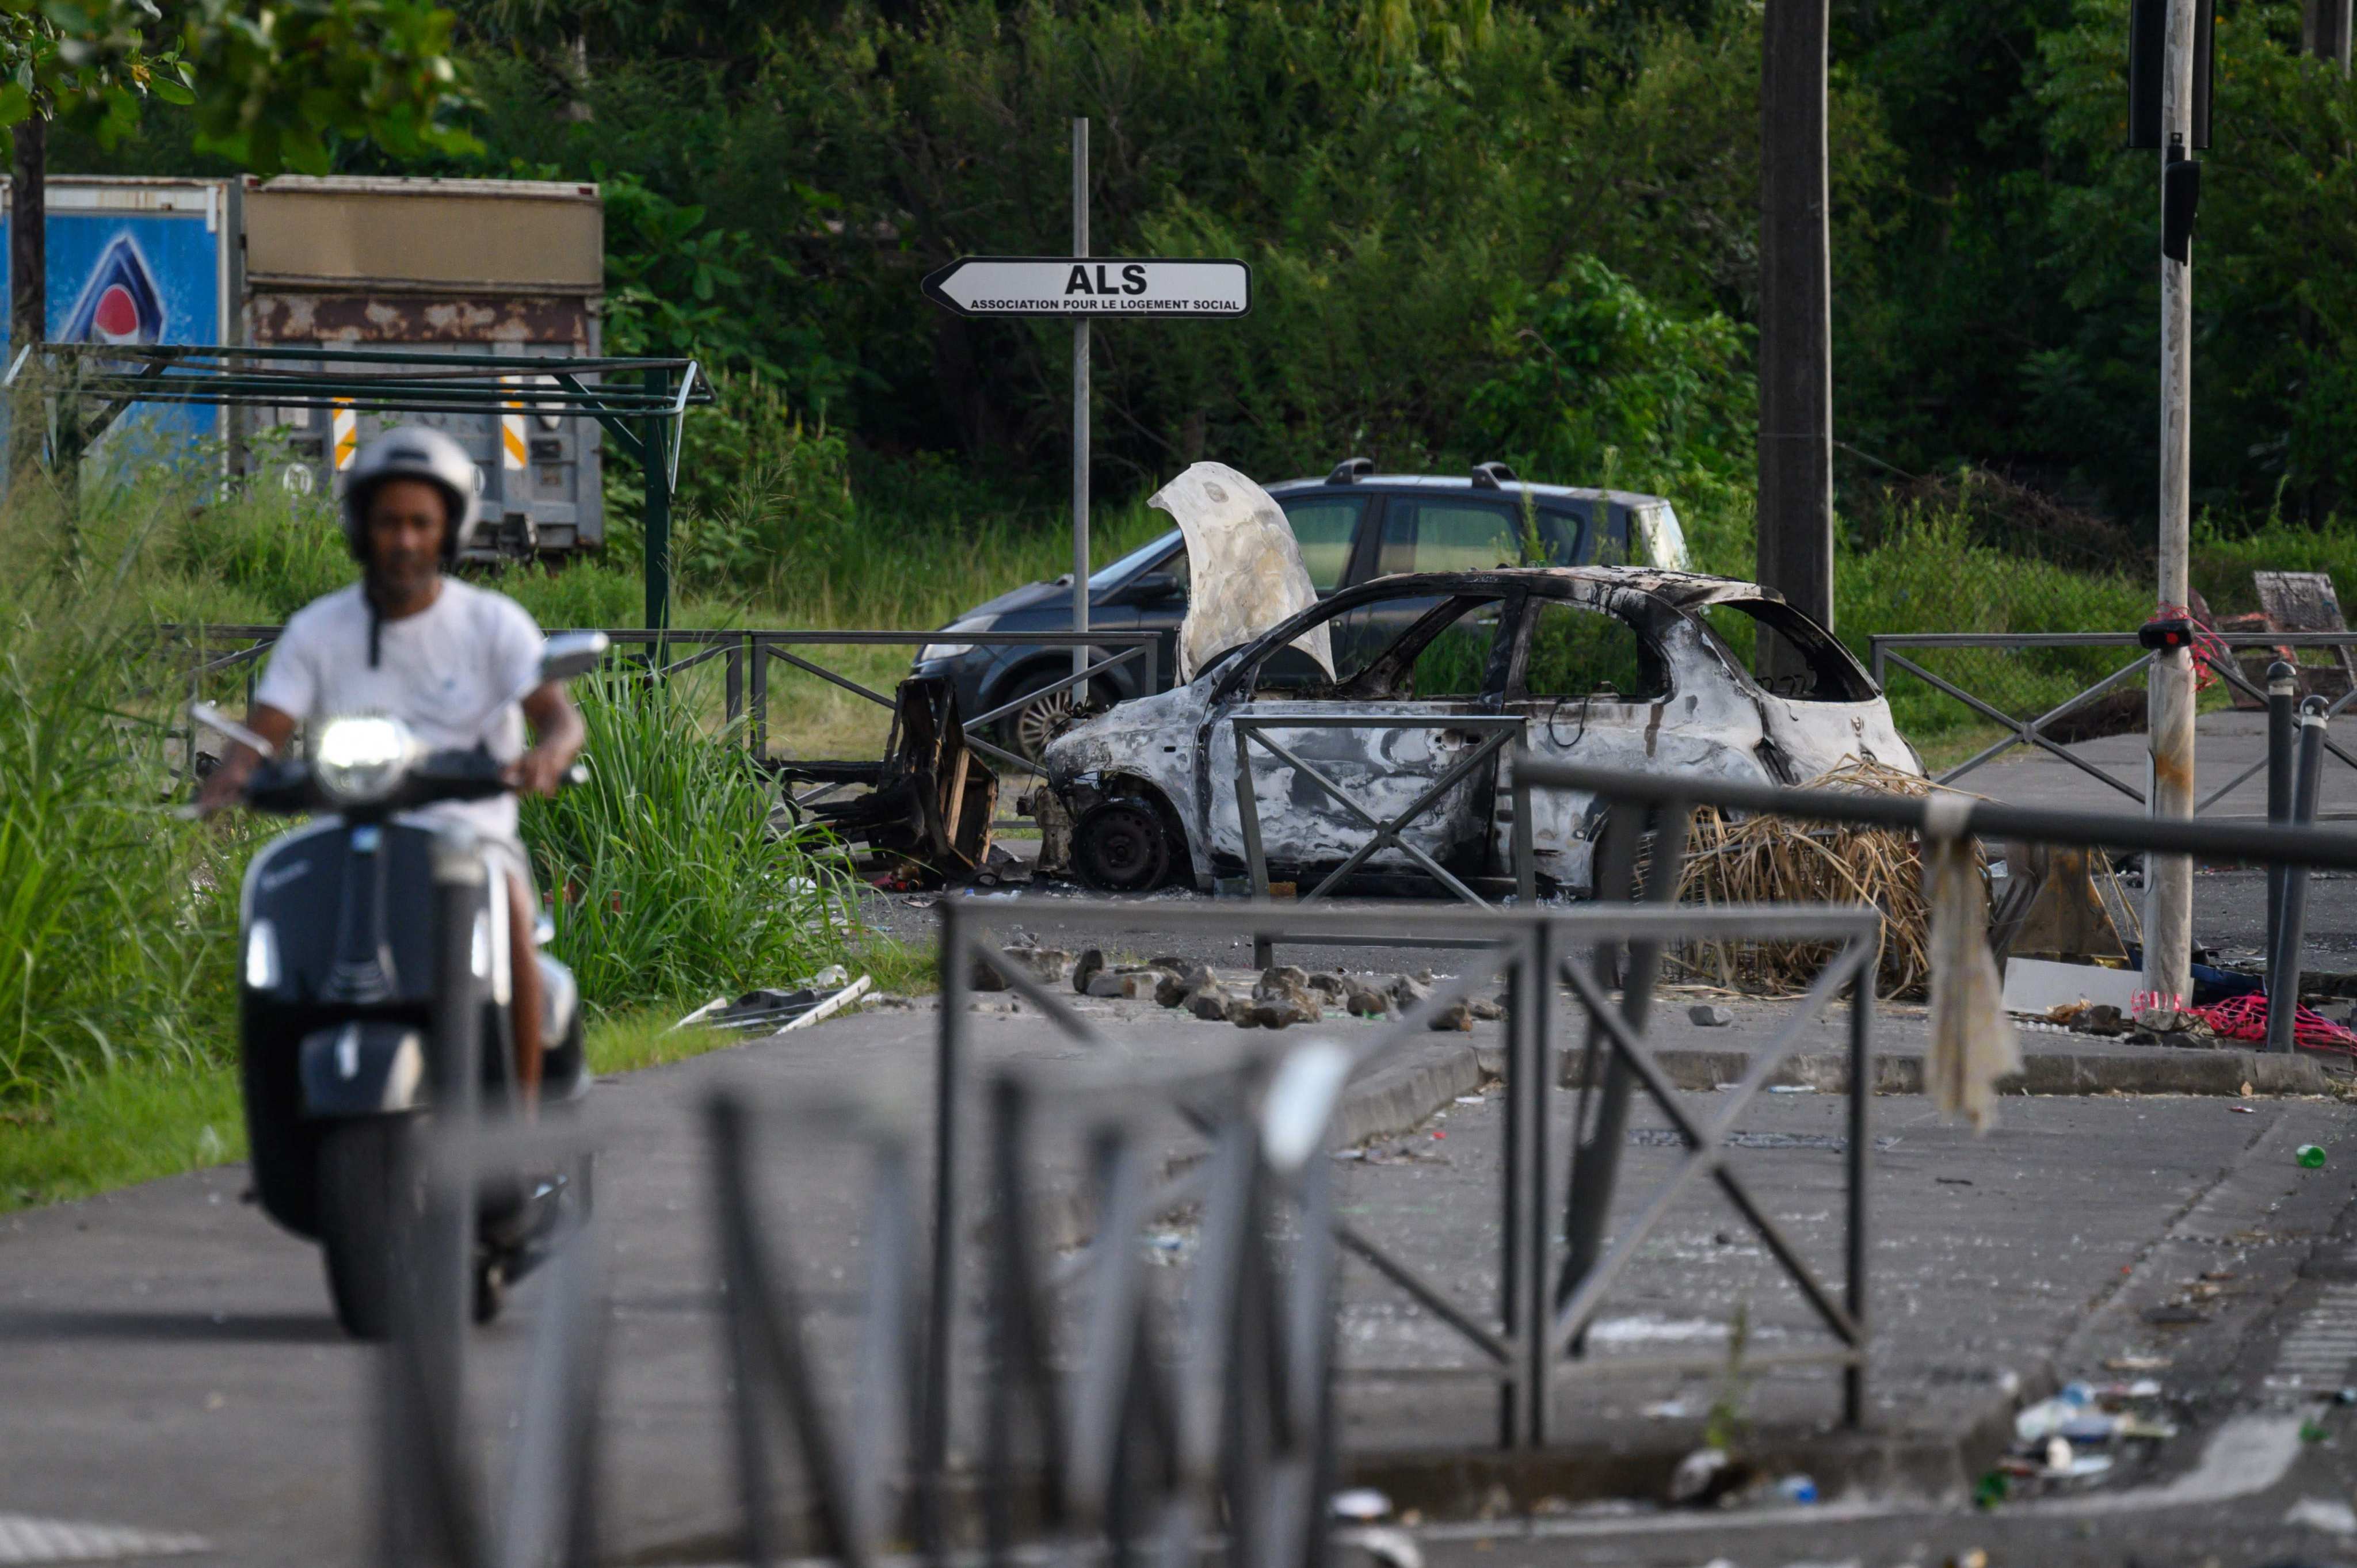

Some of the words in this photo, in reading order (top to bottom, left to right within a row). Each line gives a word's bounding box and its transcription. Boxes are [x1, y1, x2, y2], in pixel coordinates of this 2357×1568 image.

[1065, 265, 1147, 295] ALS
[971, 300, 1059, 309] ASSOCIATION
[1063, 300, 1097, 309] POUR
[1102, 300, 1116, 309] LE
[1121, 300, 1189, 309] LOGEMENT
[1193, 300, 1239, 310] SOCIAL
